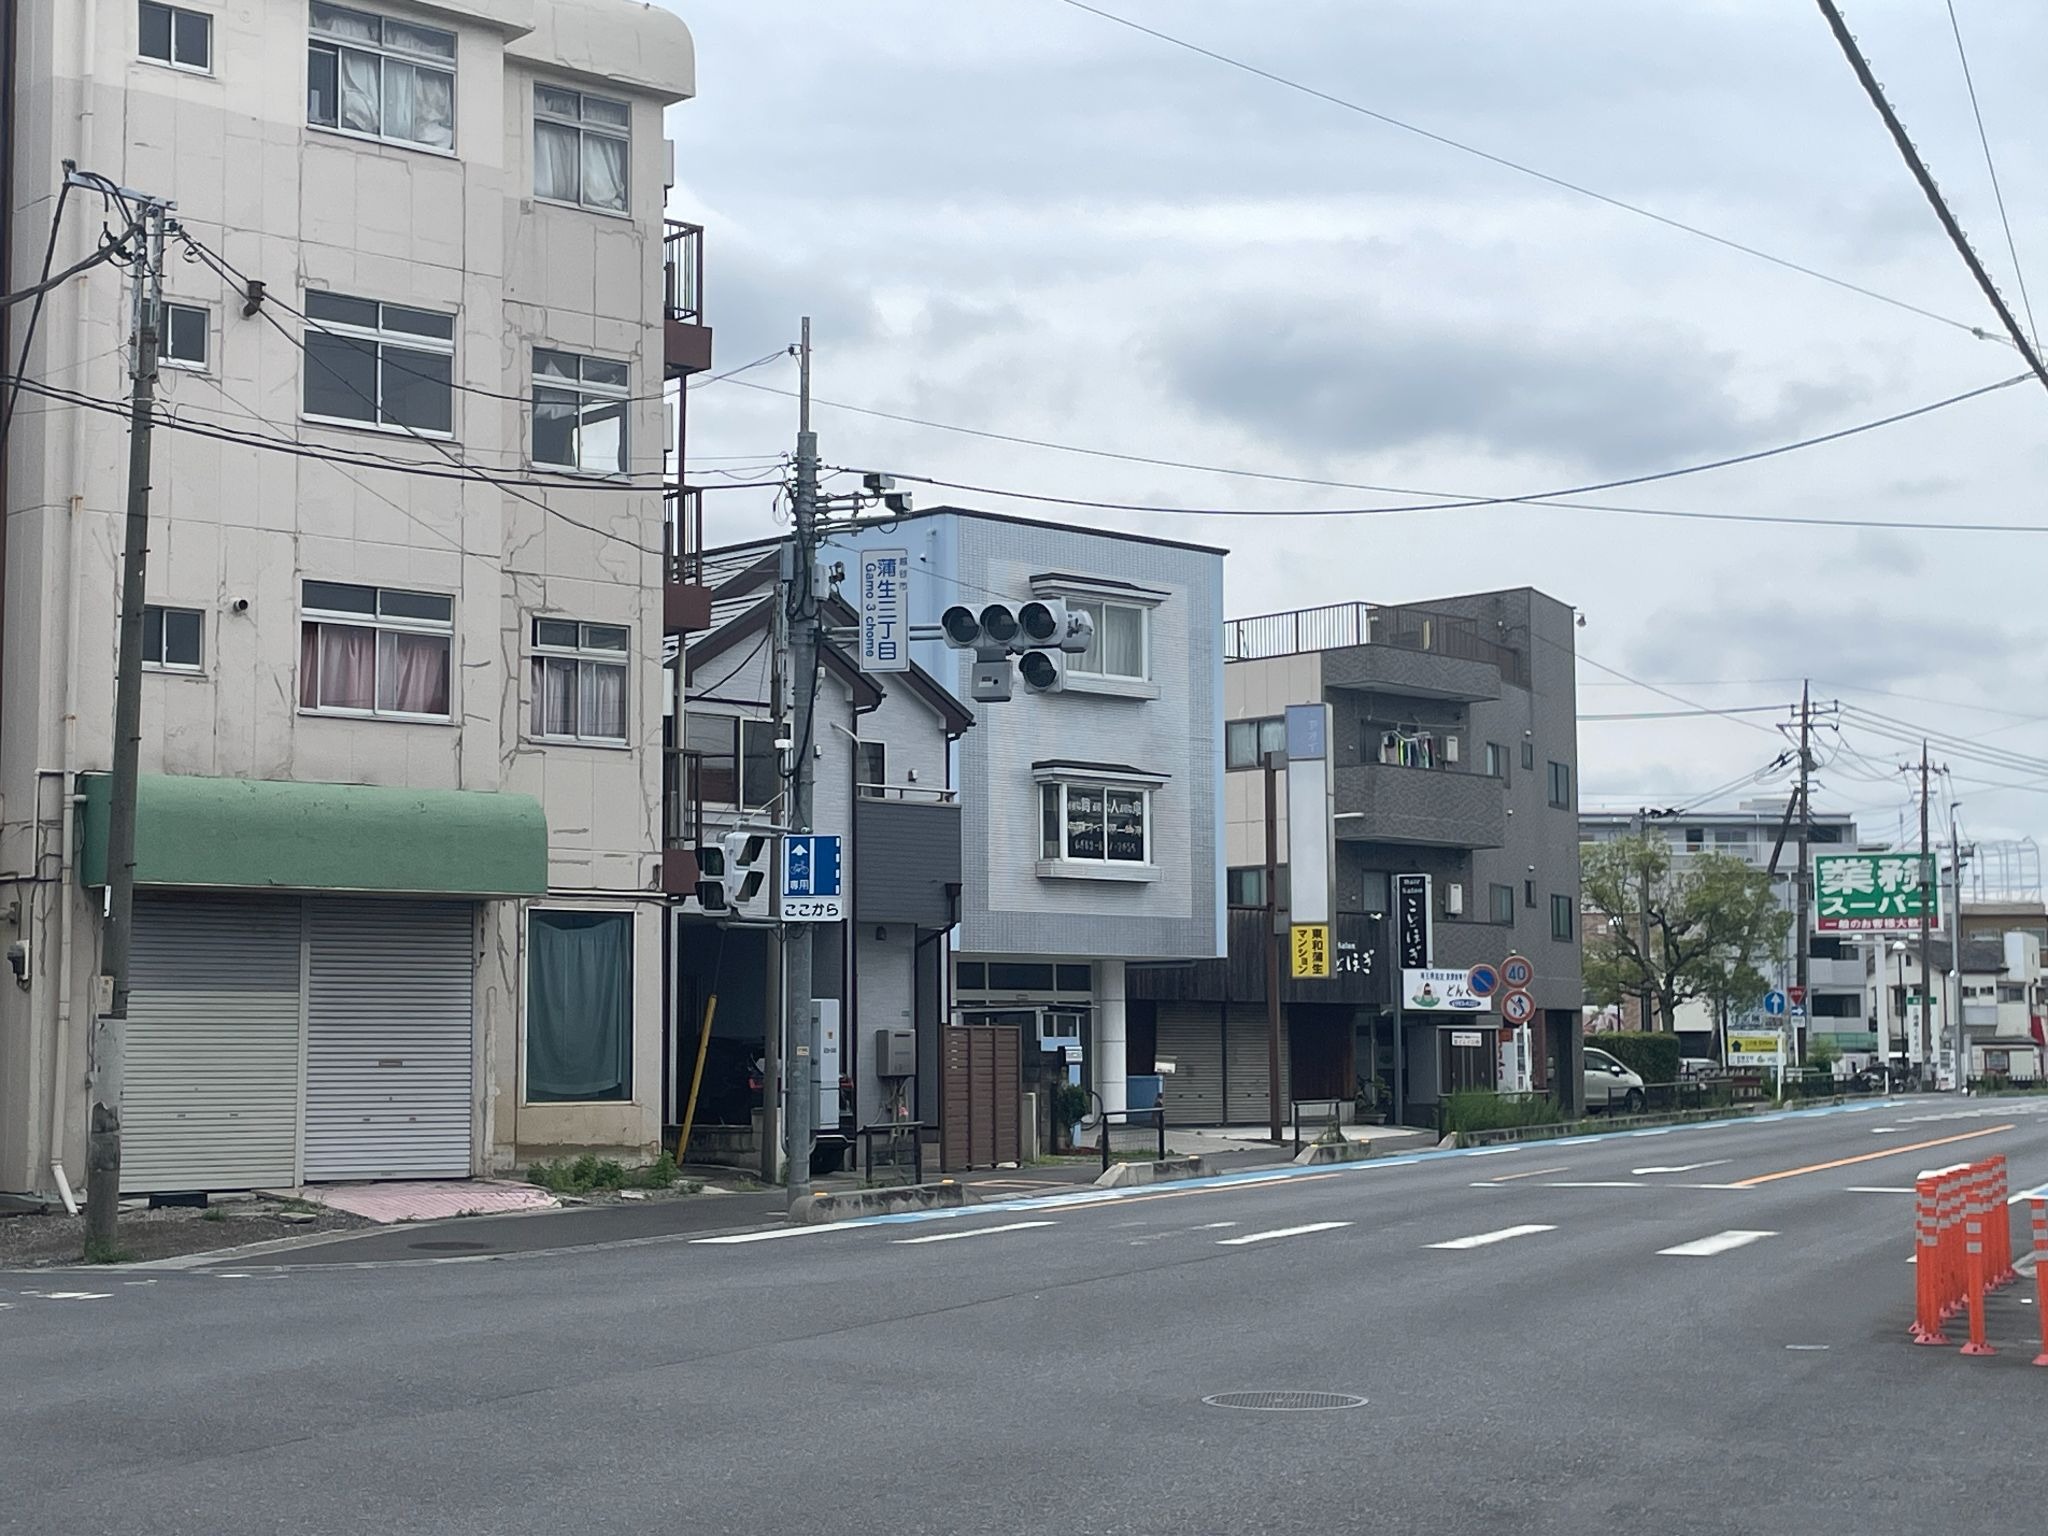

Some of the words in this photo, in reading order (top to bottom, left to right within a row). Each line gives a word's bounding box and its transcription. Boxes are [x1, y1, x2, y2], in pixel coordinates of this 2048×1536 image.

[865, 562, 877, 599] Gamo
[865, 603, 877, 612] 3
[877, 558, 897, 660] 蒲生三丁目
[865, 616, 877, 657] chome
[1820, 858, 1932, 894] 業務
[784, 903, 839, 917] ここから
[1821, 895, 1934, 916] スーパー
[1406, 898, 1422, 966] ことほぎ
[1825, 918, 1932, 930] 一般のお客様大歓
[1297, 929, 1308, 974] マンション
[1311, 928, 1323, 974] 東和蒲生
[1508, 966, 1526, 981] 40
